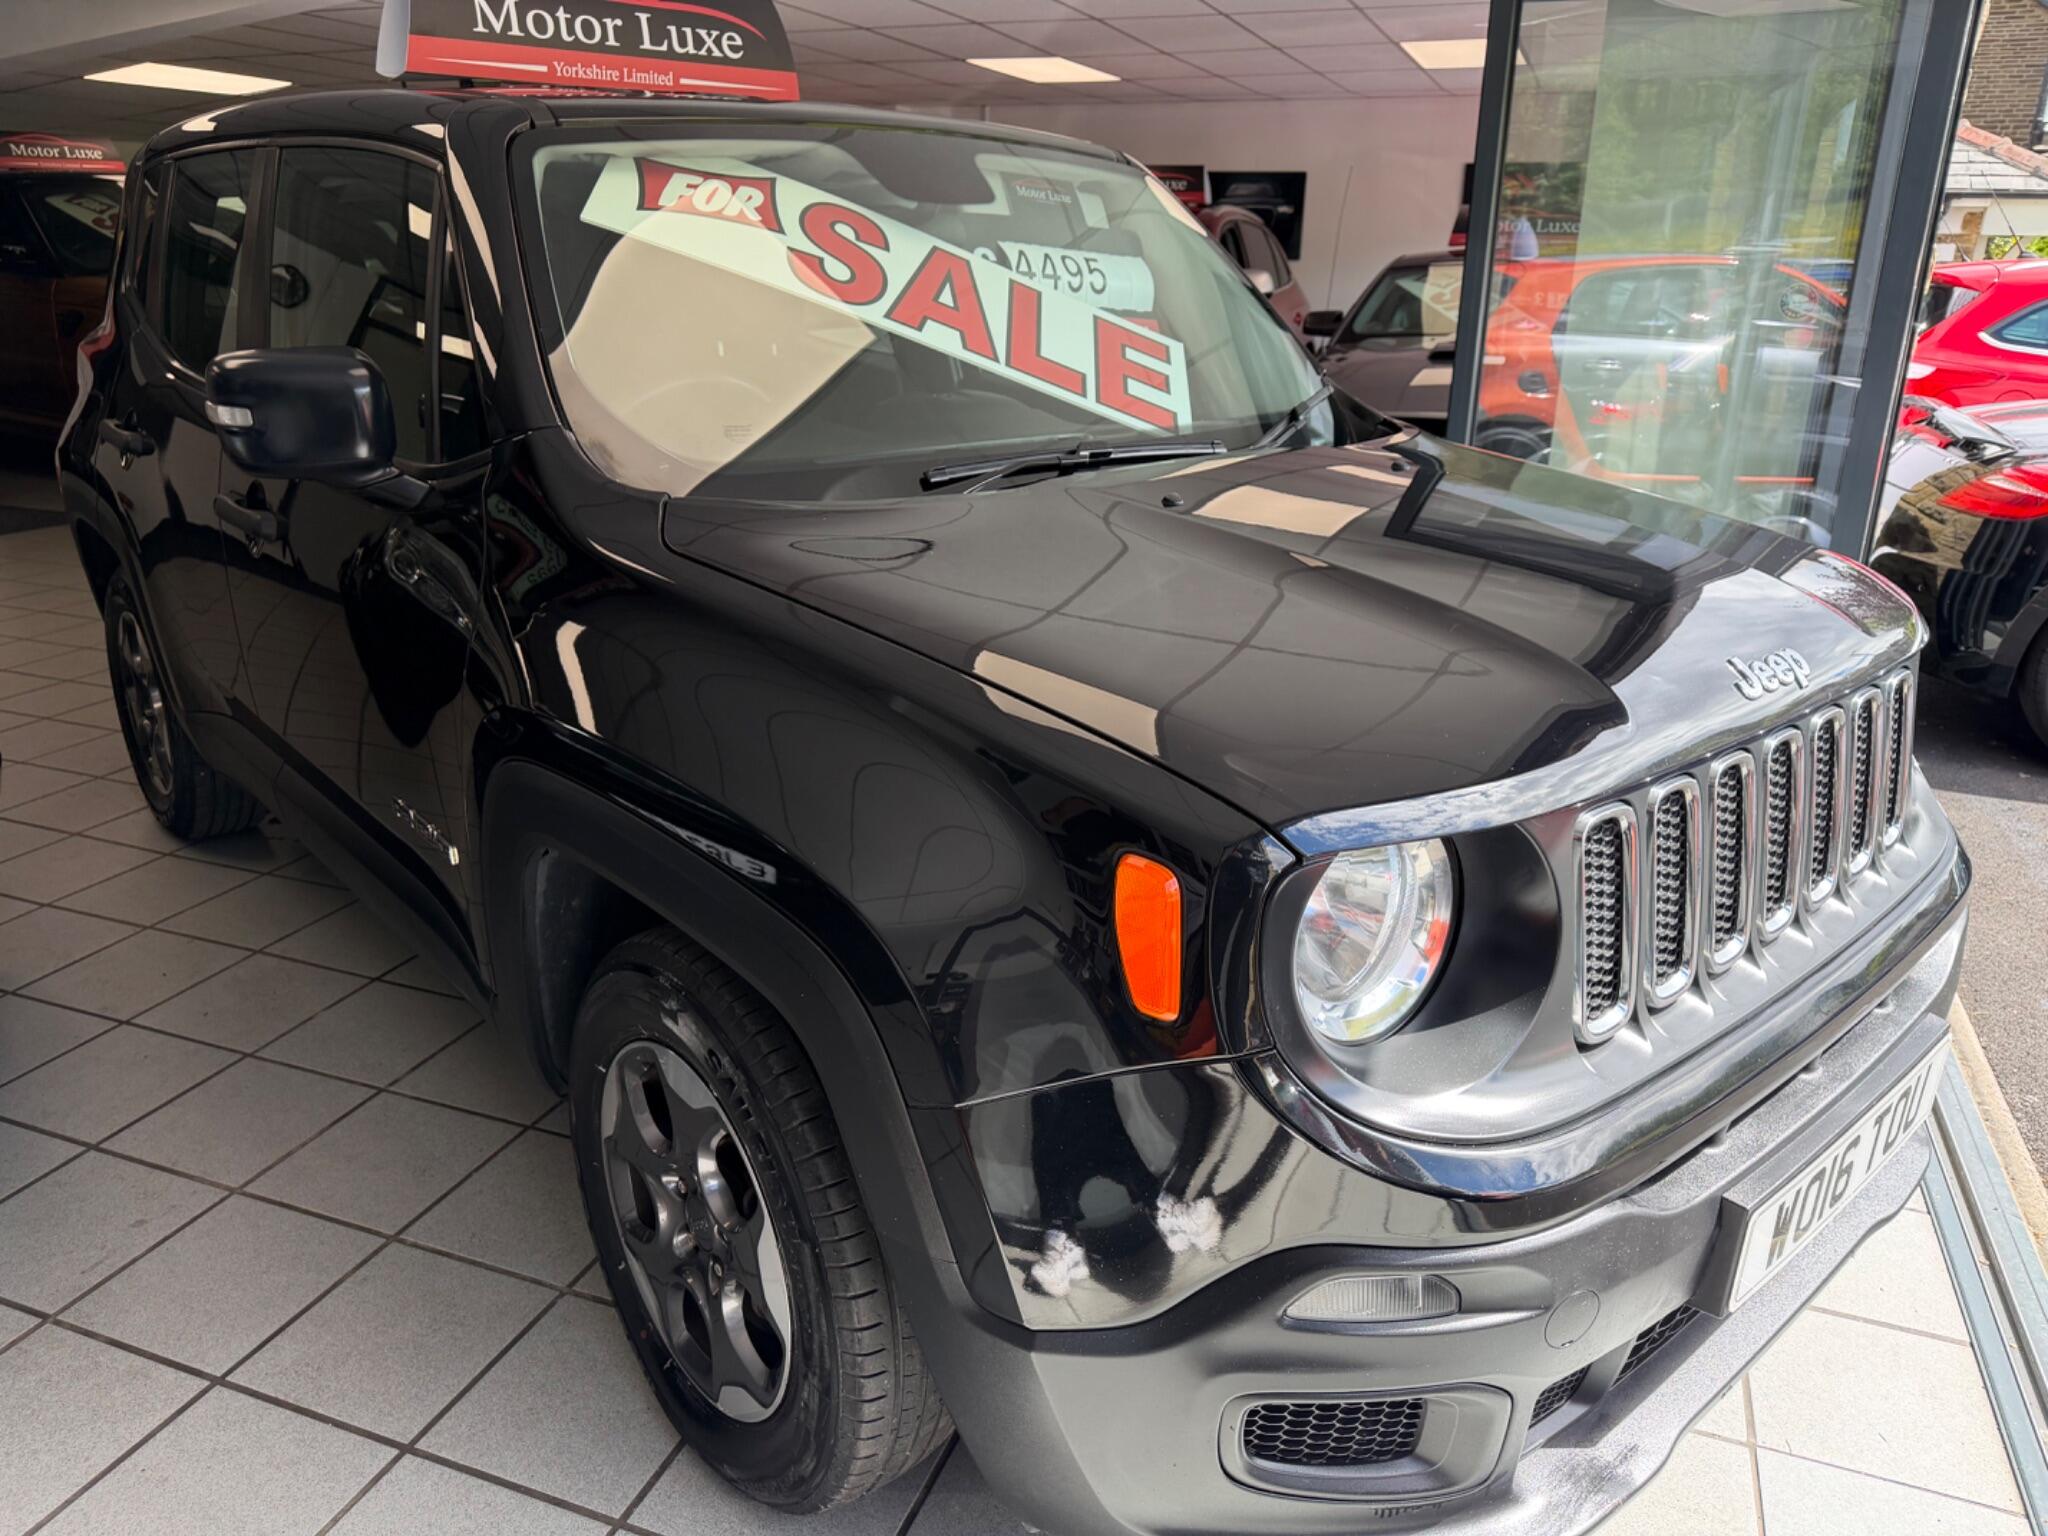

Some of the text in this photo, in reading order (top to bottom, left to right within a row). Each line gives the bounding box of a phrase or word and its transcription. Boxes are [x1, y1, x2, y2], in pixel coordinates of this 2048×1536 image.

[472, 0, 744, 59] Motor Luxe
[552, 61, 674, 86] Yorkshire Limited
[8, 143, 104, 160] Motor Luxe
[657, 172, 1179, 434] FOR SALE
[1725, 648, 1811, 701] Jeep
[1865, 1062, 1933, 1174] TOU
